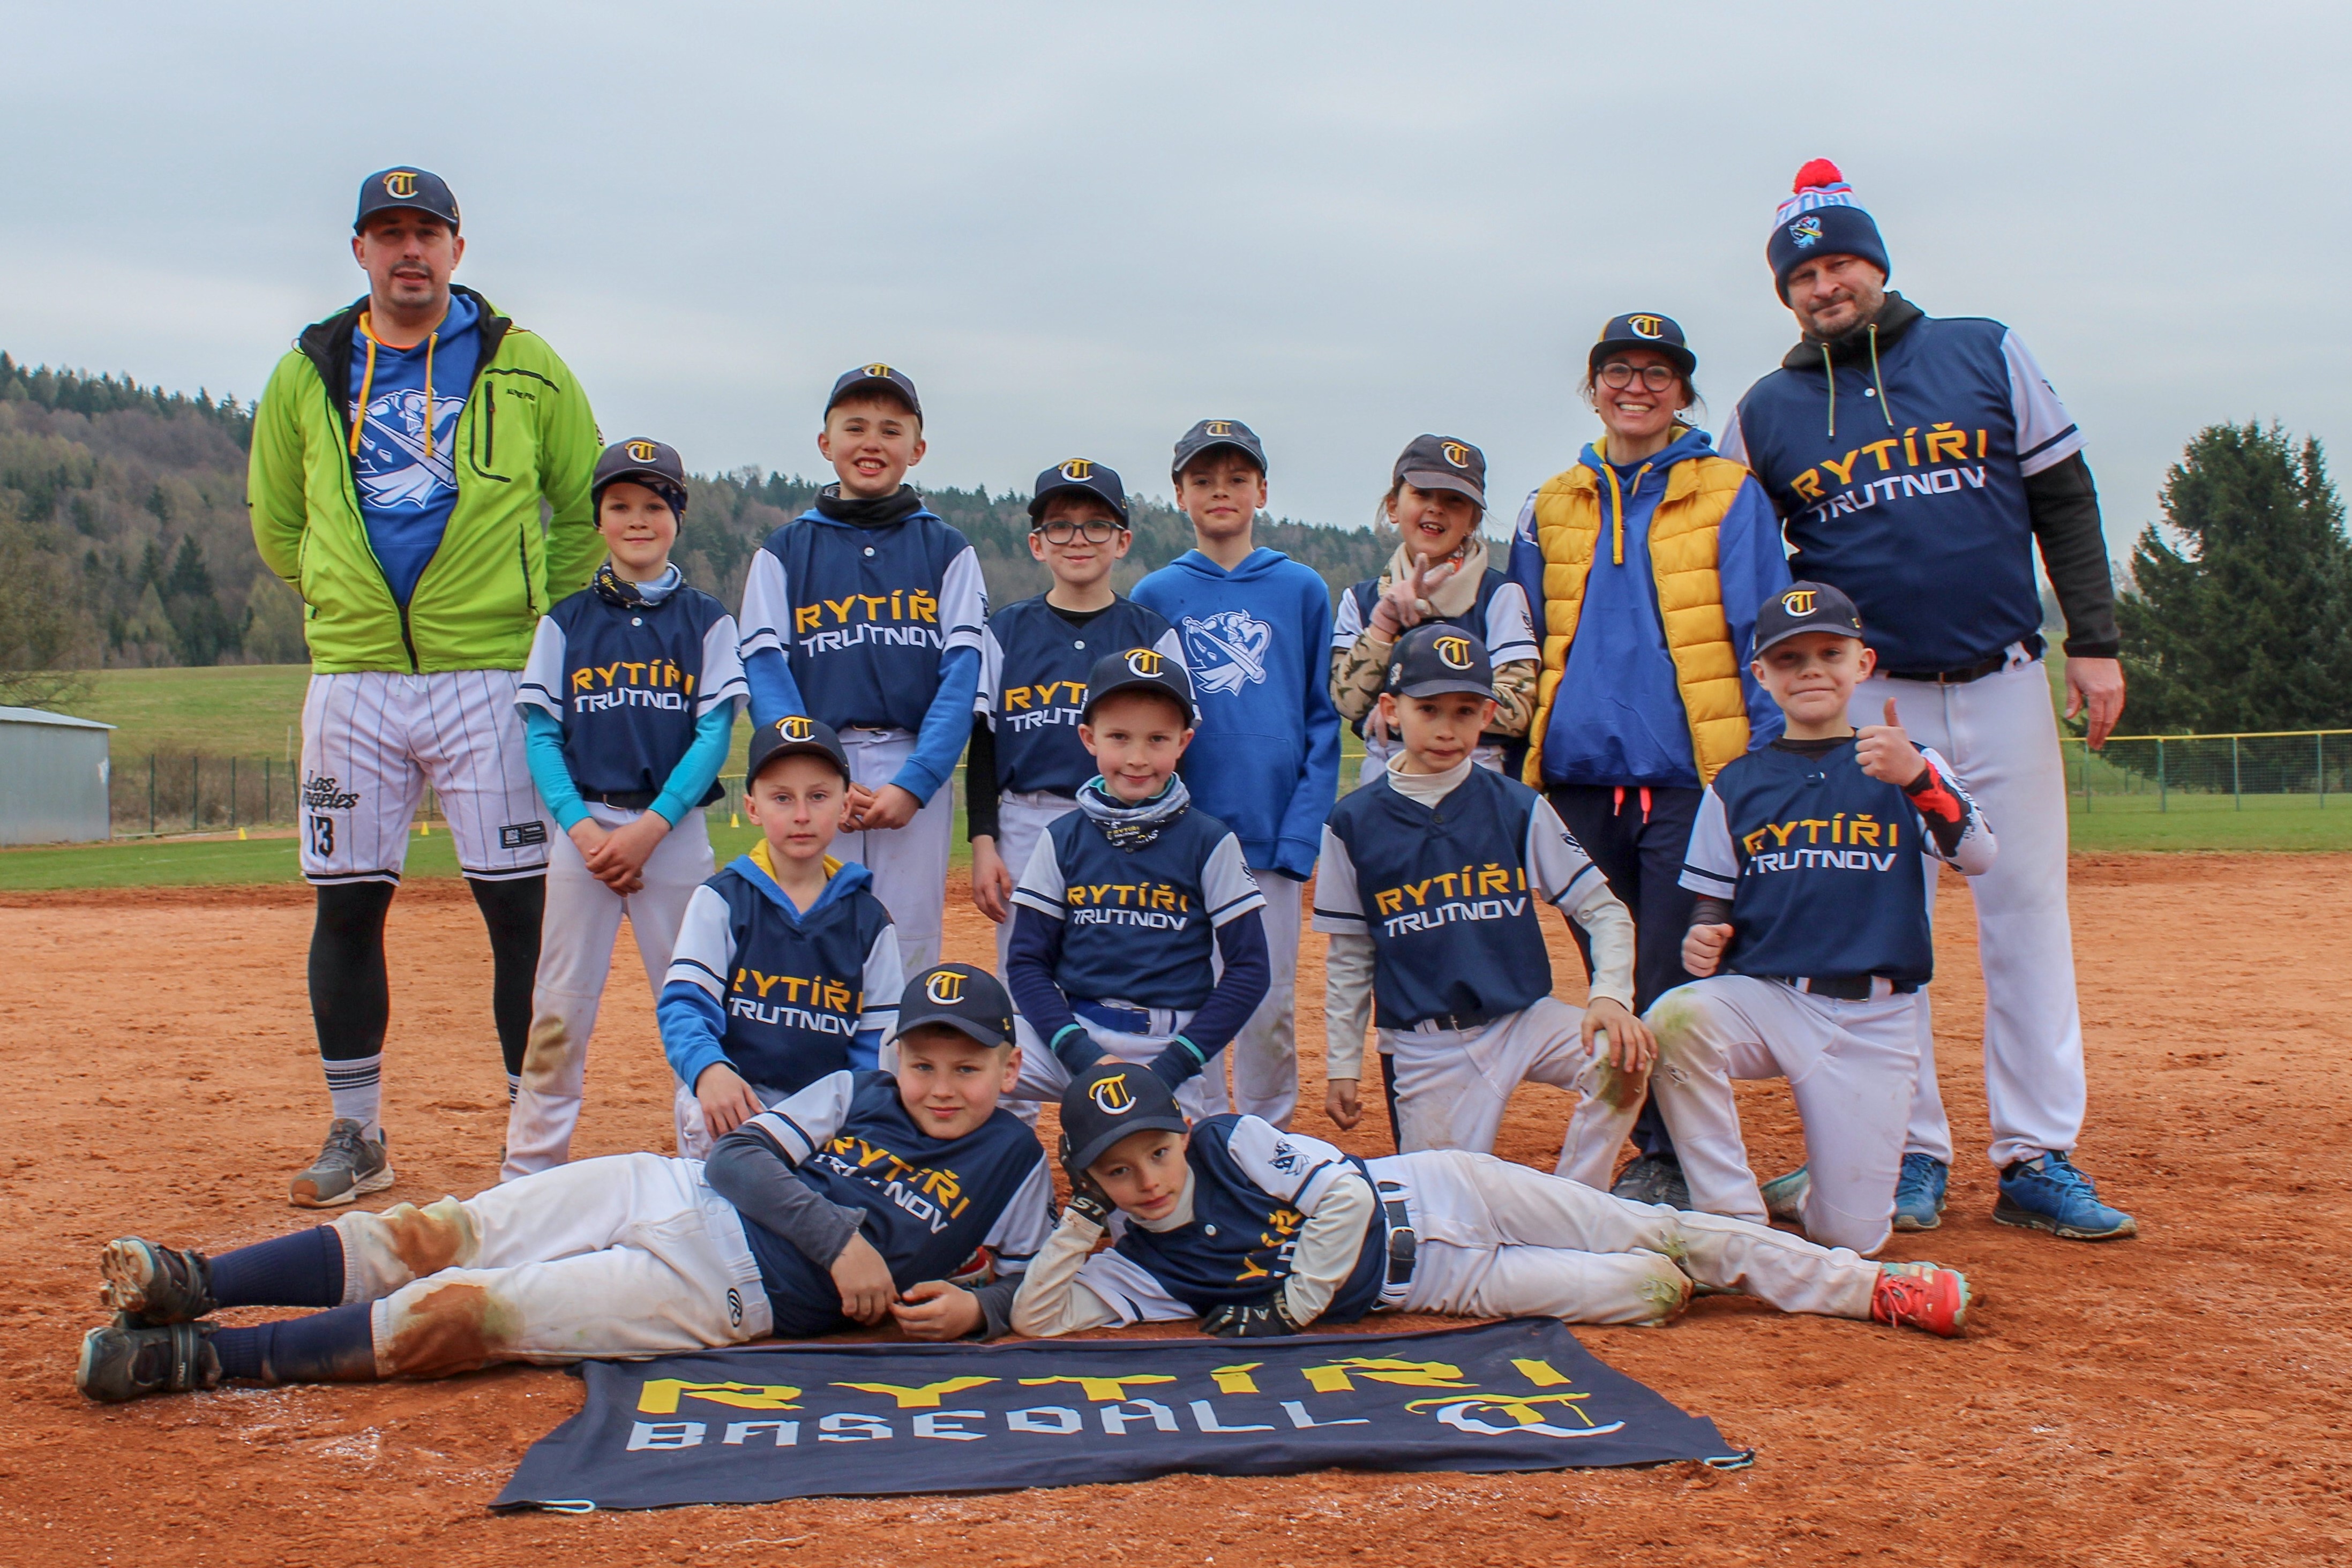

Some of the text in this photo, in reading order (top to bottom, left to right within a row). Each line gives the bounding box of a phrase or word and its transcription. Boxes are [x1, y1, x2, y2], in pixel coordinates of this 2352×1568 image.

[1790, 422, 1987, 502] RYTÍŘI
[1806, 466, 1986, 523] TRUTNOV
[796, 588, 938, 634] RYTÍŘ
[1005, 680, 1087, 711] RYT
[1006, 707, 1083, 732] TRUT
[309, 815, 335, 858] 13
[1067, 882, 1188, 912] RYTÍŘI
[1374, 862, 1526, 916] RYTÍŘI
[1073, 908, 1188, 931] TRUTNOV
[1383, 897, 1527, 937] TRUTNOV
[729, 997, 860, 1037] RUTNOV
[626, 1397, 1370, 1451] BASEBALL
